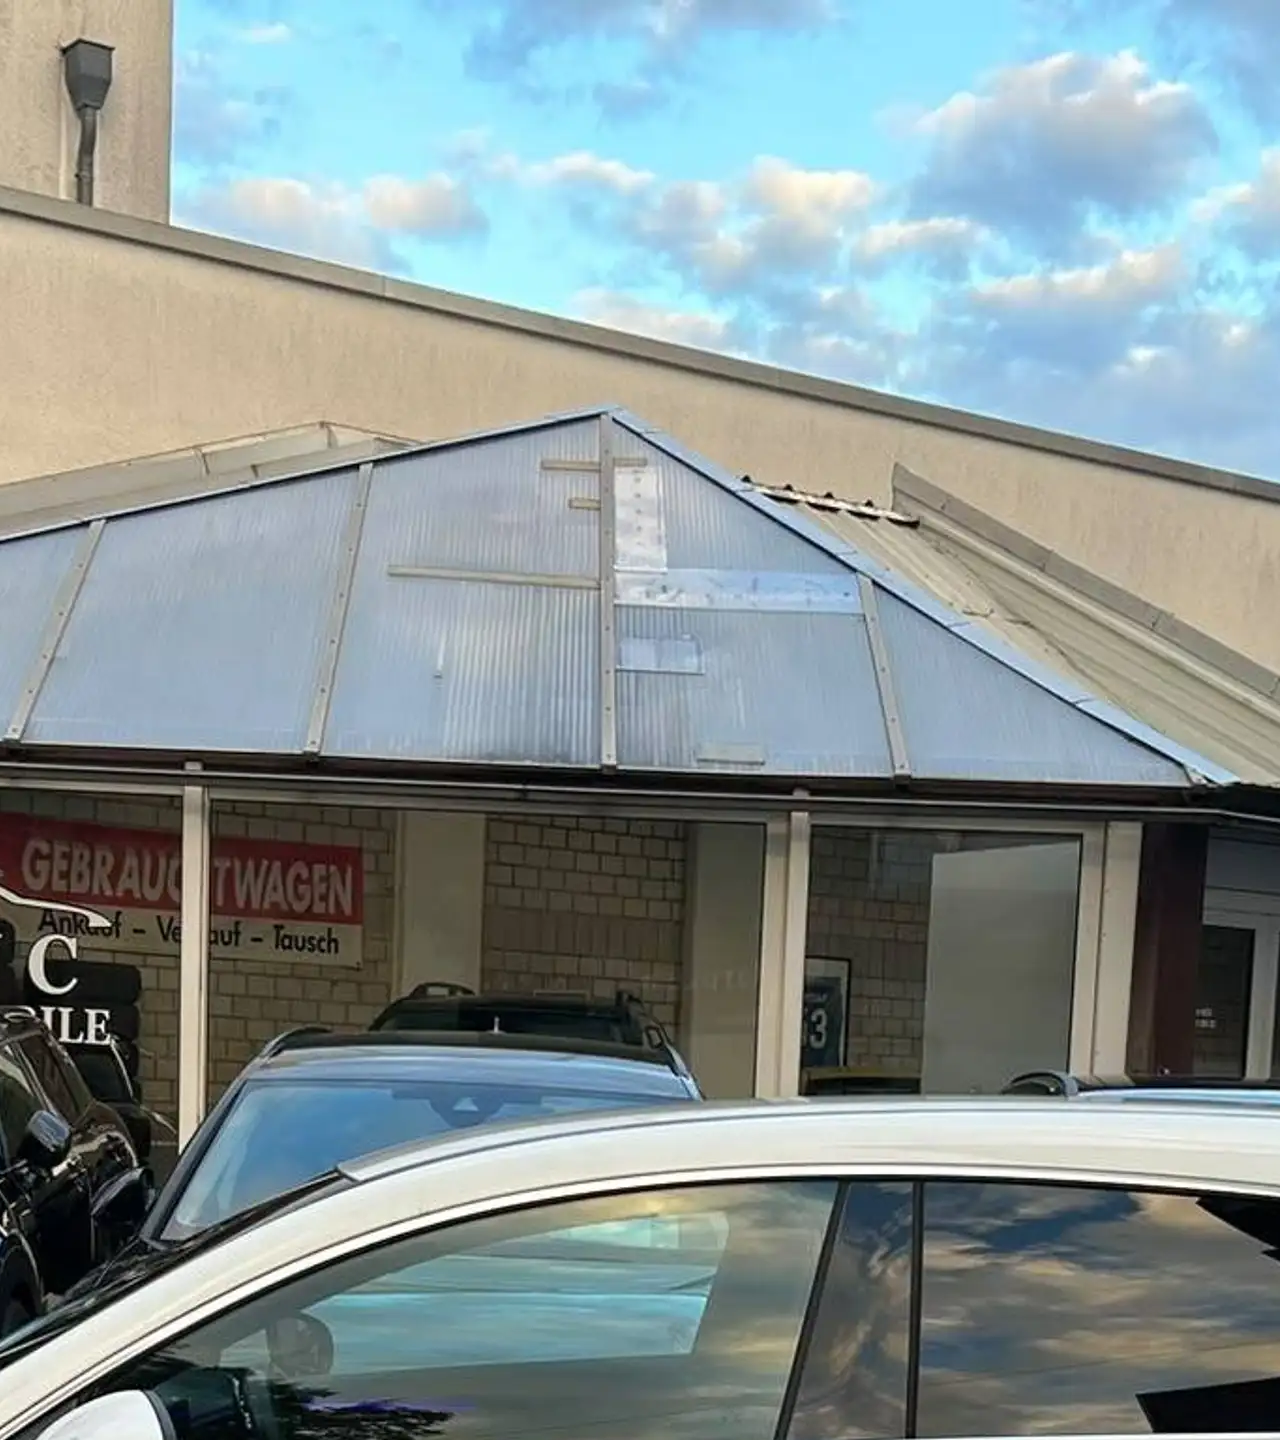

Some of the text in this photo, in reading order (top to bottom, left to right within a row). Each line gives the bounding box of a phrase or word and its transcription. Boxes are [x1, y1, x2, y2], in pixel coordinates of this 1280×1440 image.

[21, 839, 354, 916] GEBRAUCTWAGEN
[156, 914, 241, 947] Veauf
[274, 924, 339, 954] Tausch
